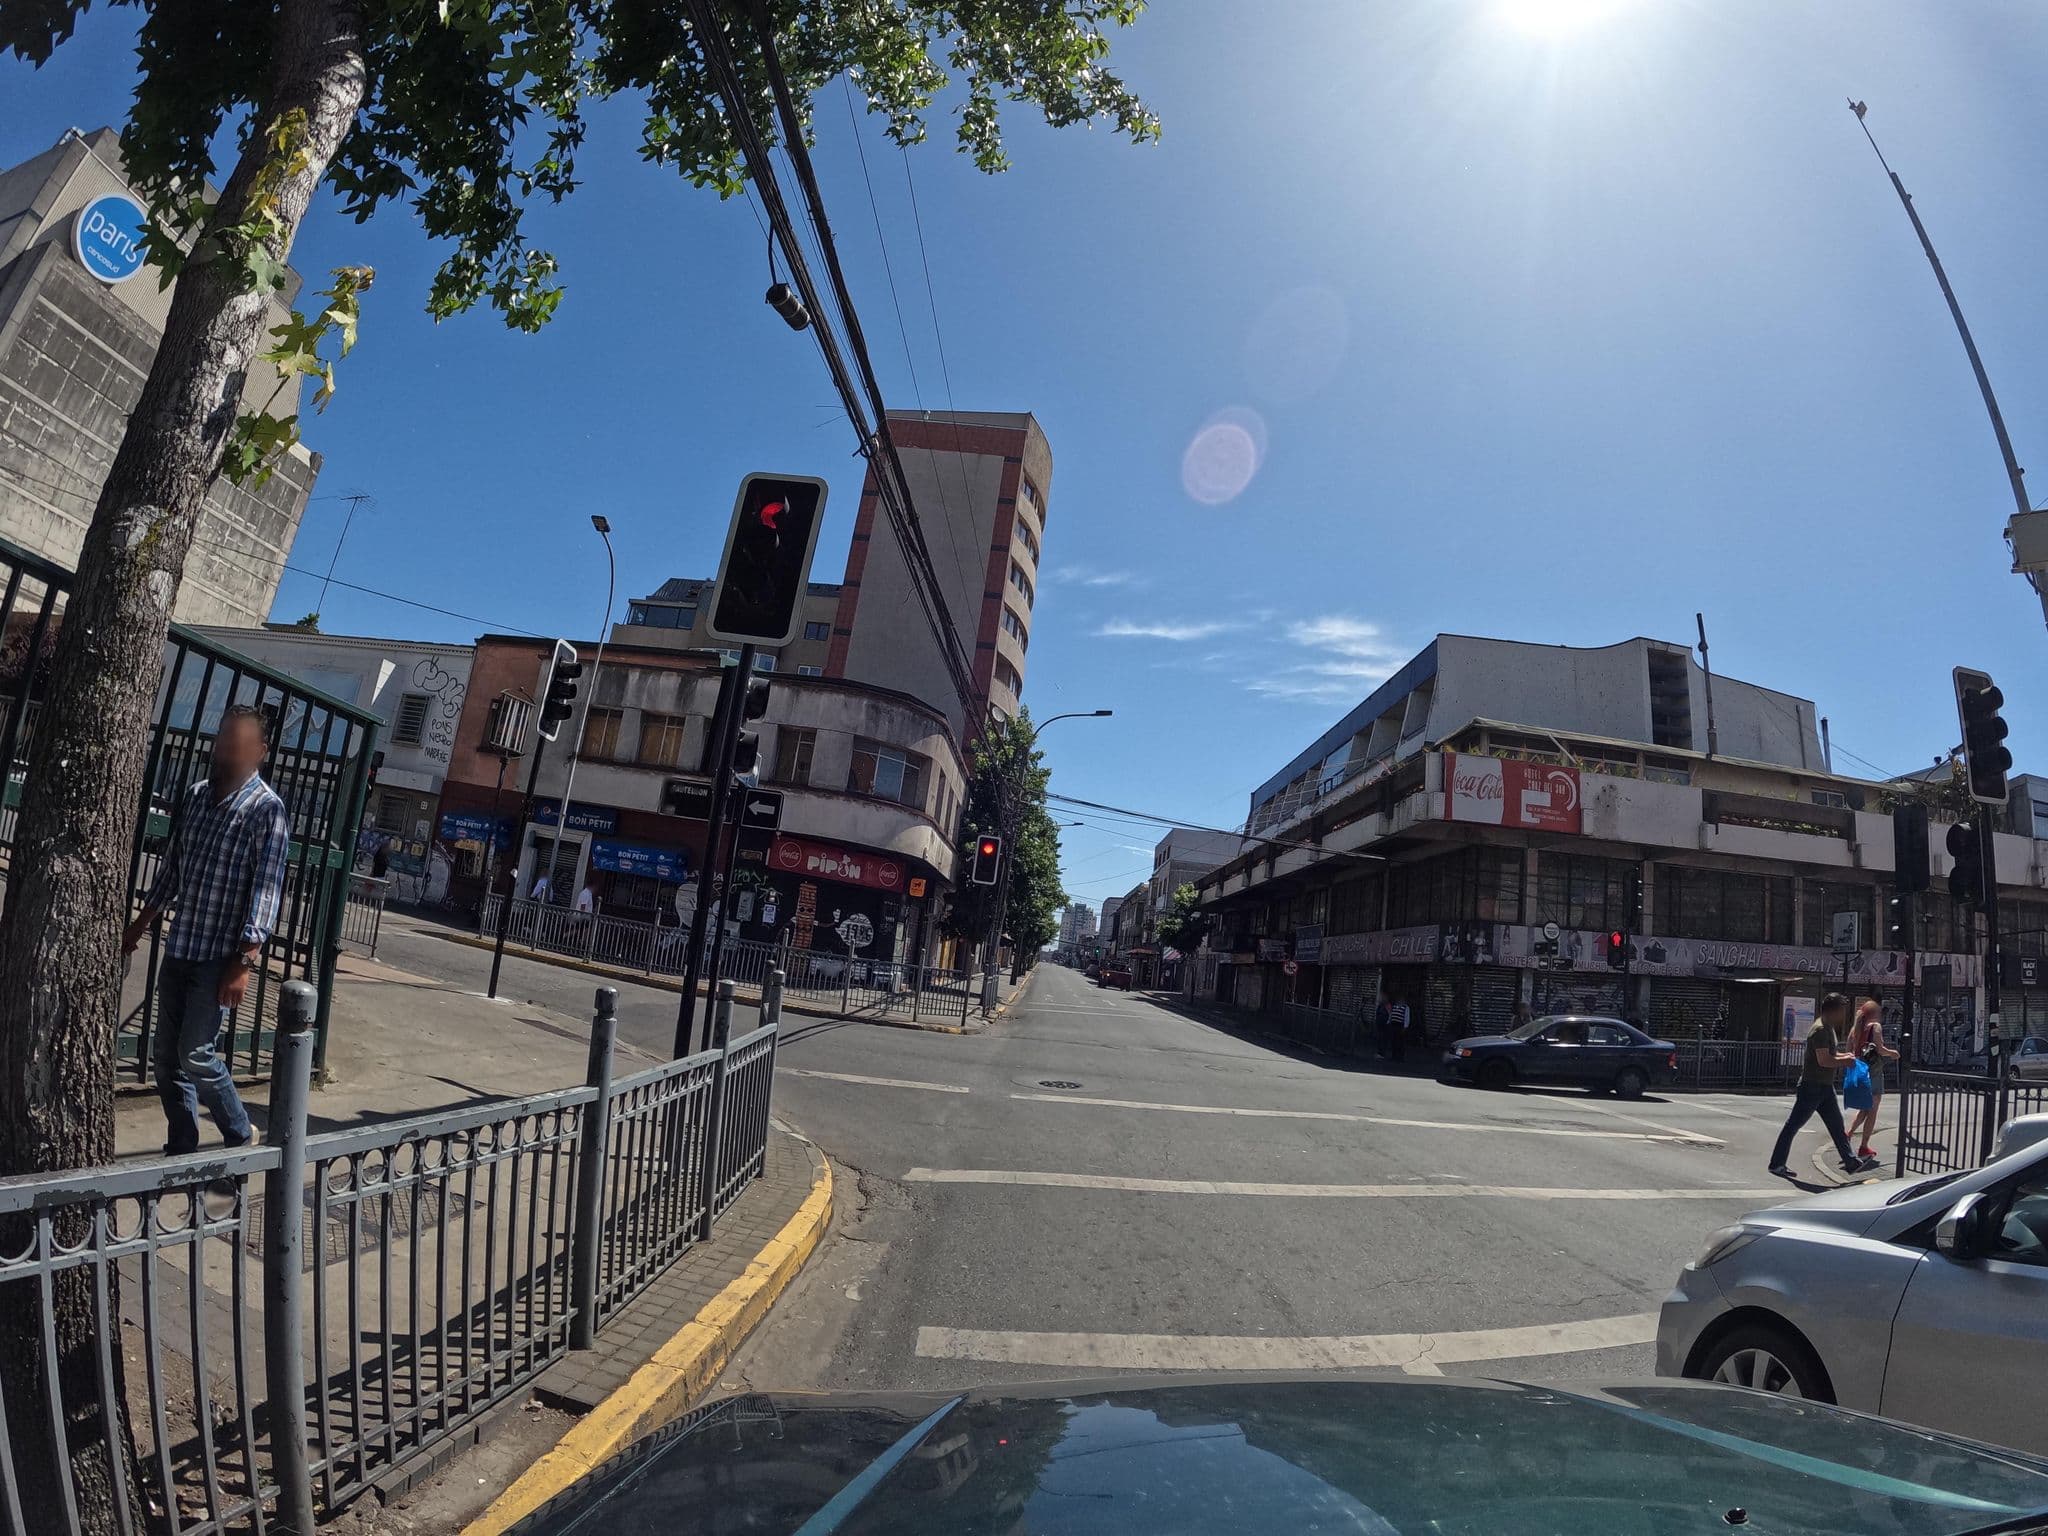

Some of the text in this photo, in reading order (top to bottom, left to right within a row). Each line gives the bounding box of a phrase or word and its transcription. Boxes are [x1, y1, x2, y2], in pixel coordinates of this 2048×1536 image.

[568, 815, 587, 826] BON
[588, 818, 613, 830] PETIT
[618, 850, 632, 859] BON
[632, 852, 649, 862] PETIT
[1389, 935, 1437, 957] CHILE
[1697, 943, 1762, 968] SANGHAI
[1796, 958, 1845, 977] CHILE
